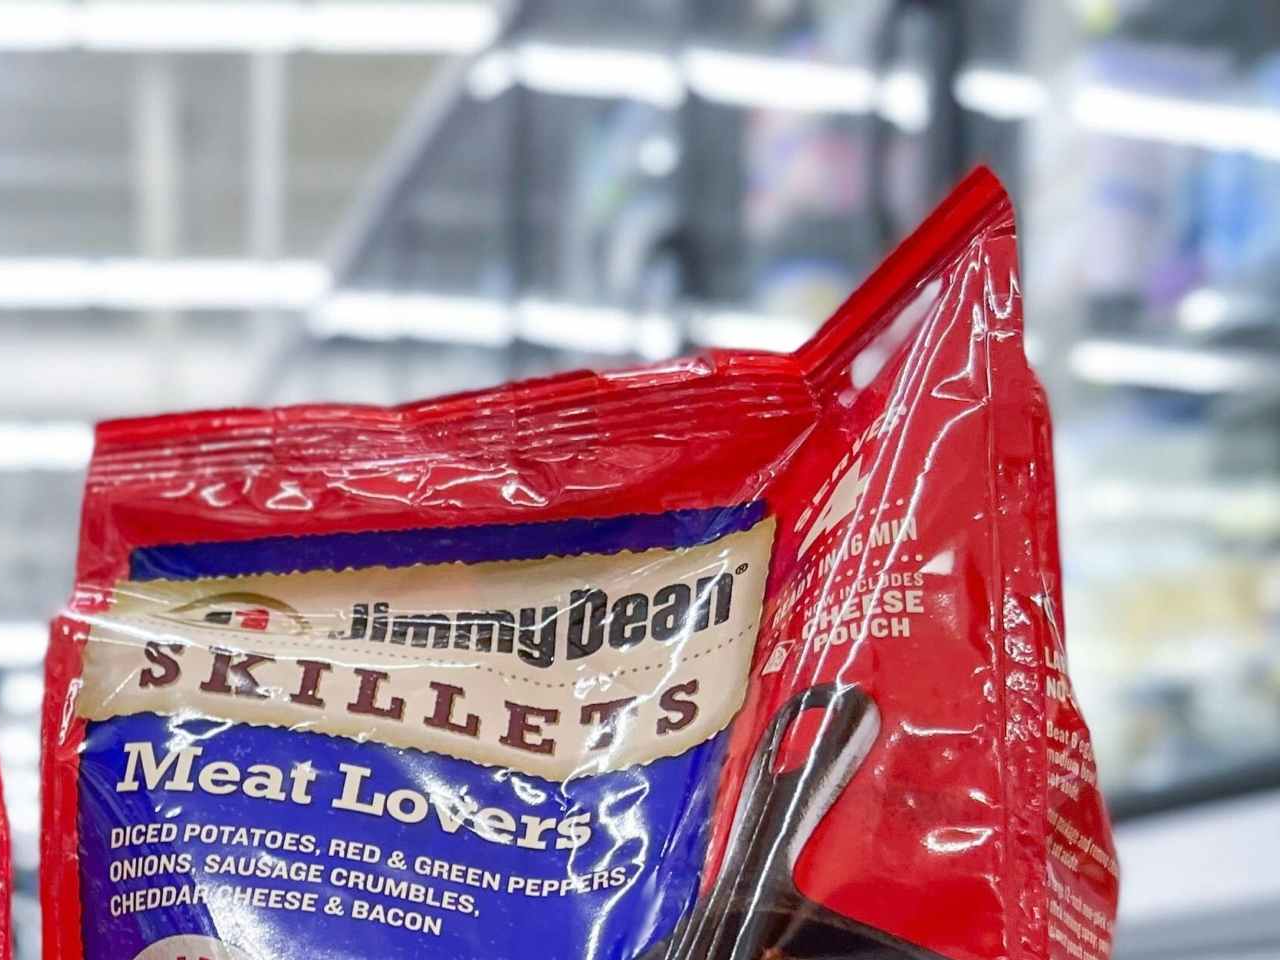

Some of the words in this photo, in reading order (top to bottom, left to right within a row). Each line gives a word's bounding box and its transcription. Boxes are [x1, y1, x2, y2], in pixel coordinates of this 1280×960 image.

[797, 452, 872, 562] 4
[870, 515, 918, 548] MIN
[328, 600, 558, 669] Jimmy
[801, 590, 925, 641] CHEESE
[813, 617, 912, 655] POUCH
[138, 641, 701, 756] SKILLETS
[116, 741, 321, 805] Meat
[331, 761, 593, 852] Lovers
[109, 854, 198, 883] ONIONS,
[204, 854, 325, 885] SAUSAGE
[331, 868, 481, 919] CRUMBLES,
[110, 823, 178, 850] DICED
[183, 826, 322, 857] POTATOES,
[328, 839, 382, 864] RED
[387, 850, 408, 870] &
[413, 857, 502, 892] GREEN
[507, 866, 634, 898] PEPPERS,
[109, 885, 210, 917] CHEDDAR
[324, 895, 345, 917] &
[351, 897, 444, 937] BACON
